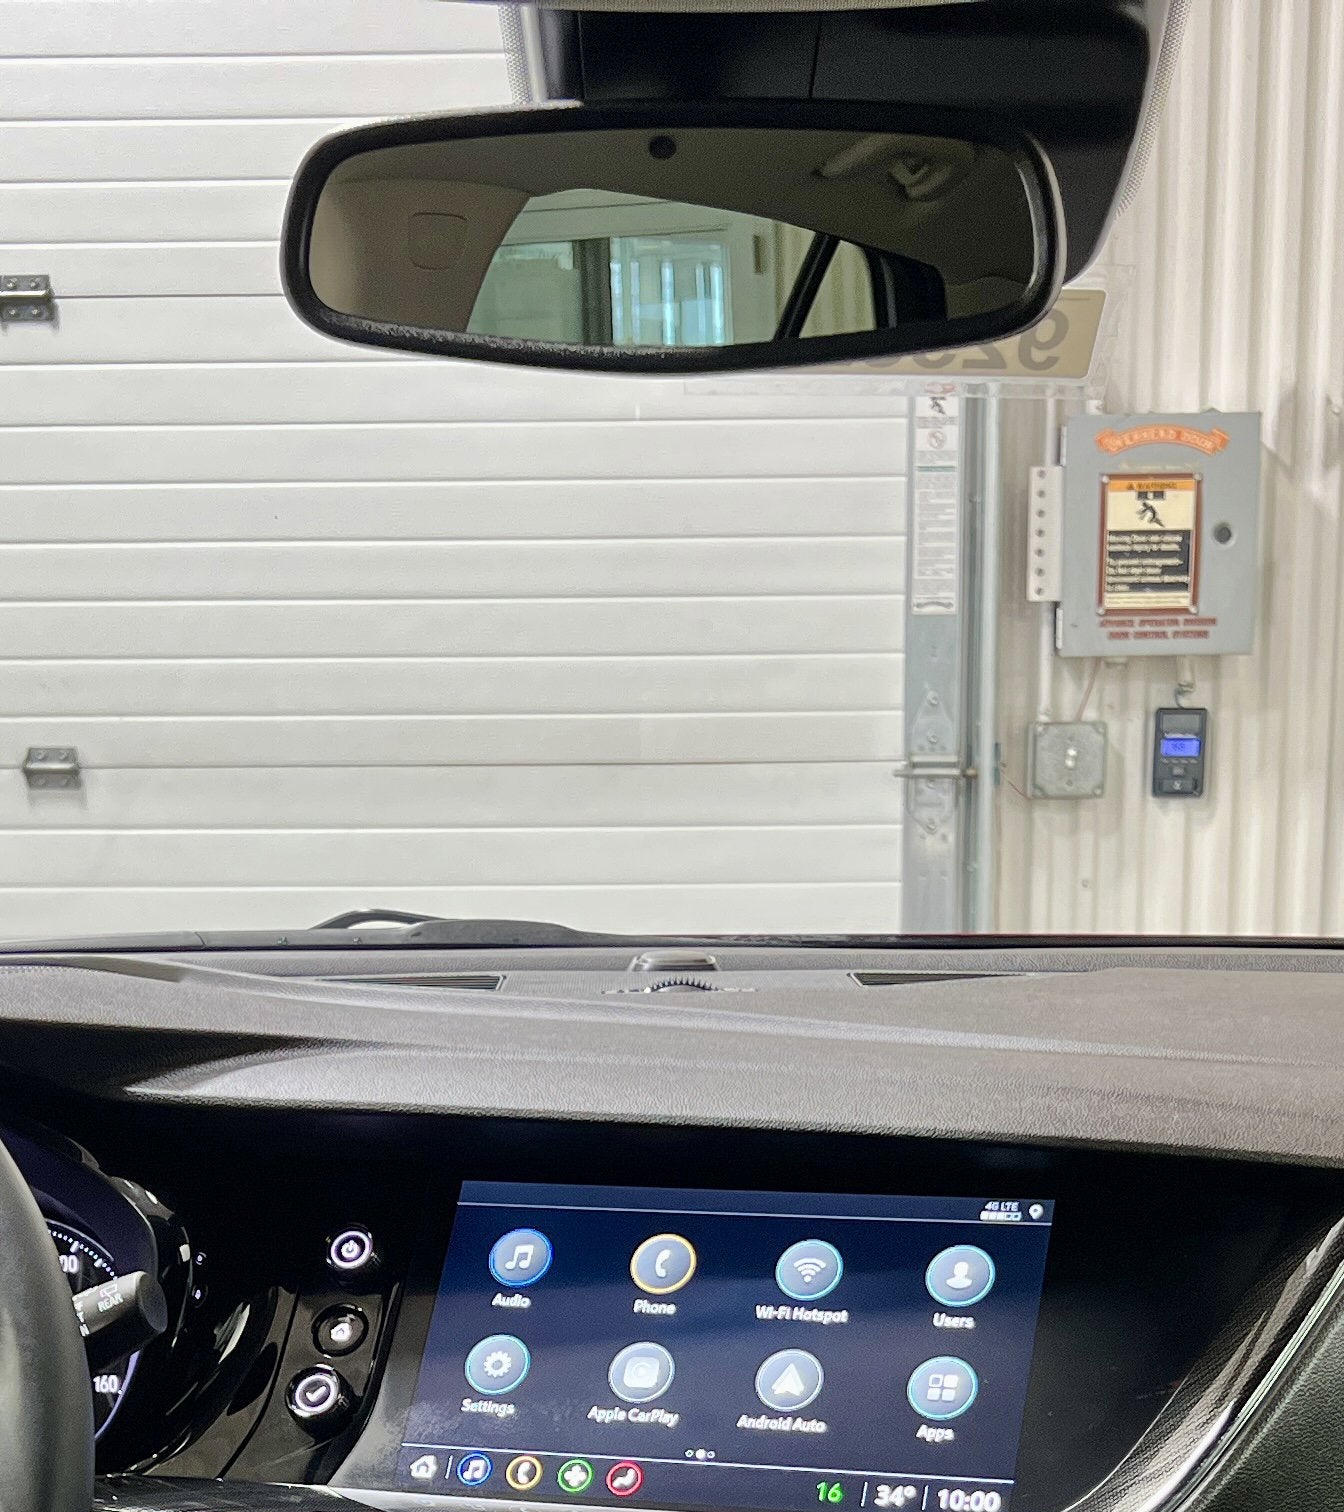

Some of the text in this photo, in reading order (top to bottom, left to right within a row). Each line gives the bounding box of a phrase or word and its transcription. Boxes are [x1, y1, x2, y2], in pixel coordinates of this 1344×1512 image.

[985, 1201, 1019, 1211] 4G LTE
[98, 1293, 123, 1312] REAR
[491, 1292, 532, 1309] Audio
[633, 1298, 676, 1316] Phone
[756, 1304, 849, 1325] Wi-Fi Hotspot
[932, 1311, 975, 1329] Users
[93, 1375, 118, 1394] 160
[460, 1398, 516, 1417] Settings
[587, 1405, 680, 1427] Apple CarPlay
[737, 1414, 828, 1433] Android Auto
[916, 1424, 955, 1443] Apps
[816, 1481, 844, 1503] 16
